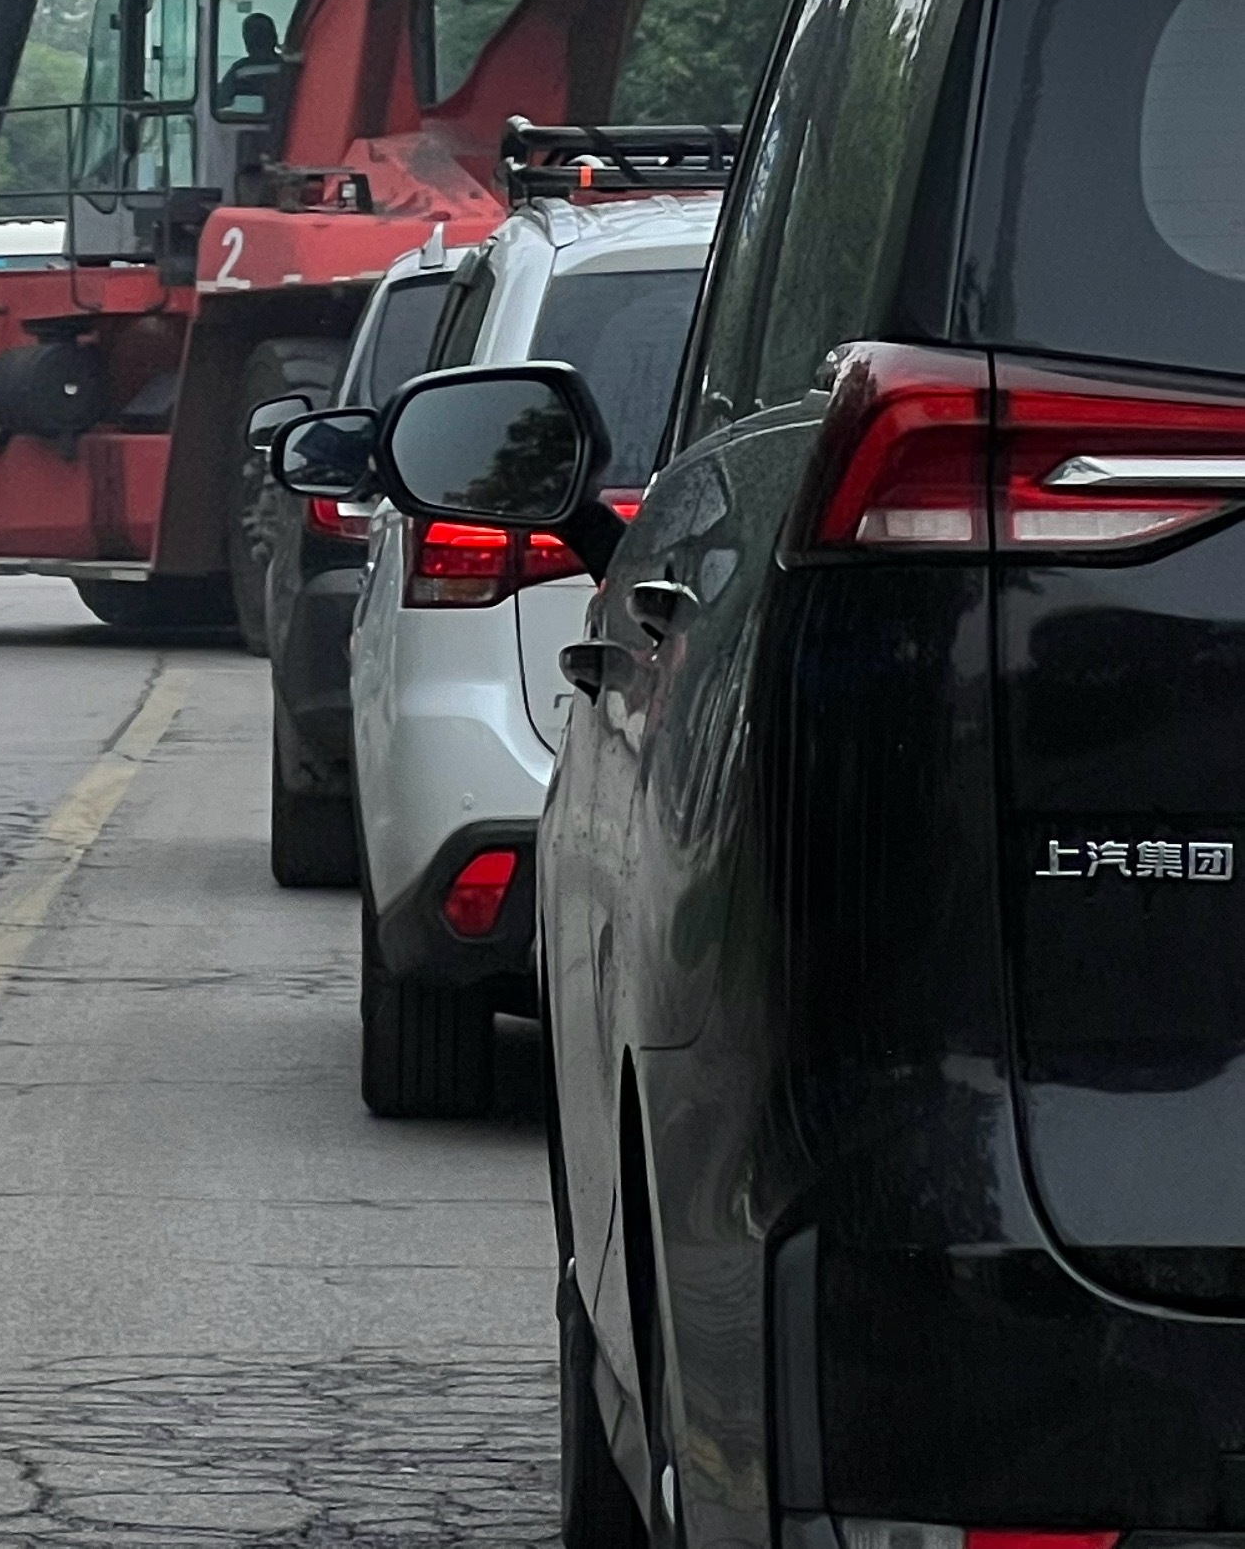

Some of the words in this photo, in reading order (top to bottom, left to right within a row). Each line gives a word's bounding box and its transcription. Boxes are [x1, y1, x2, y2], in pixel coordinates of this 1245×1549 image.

[216, 226, 251, 290] 2
[1034, 839, 1234, 881] 上汽集团
